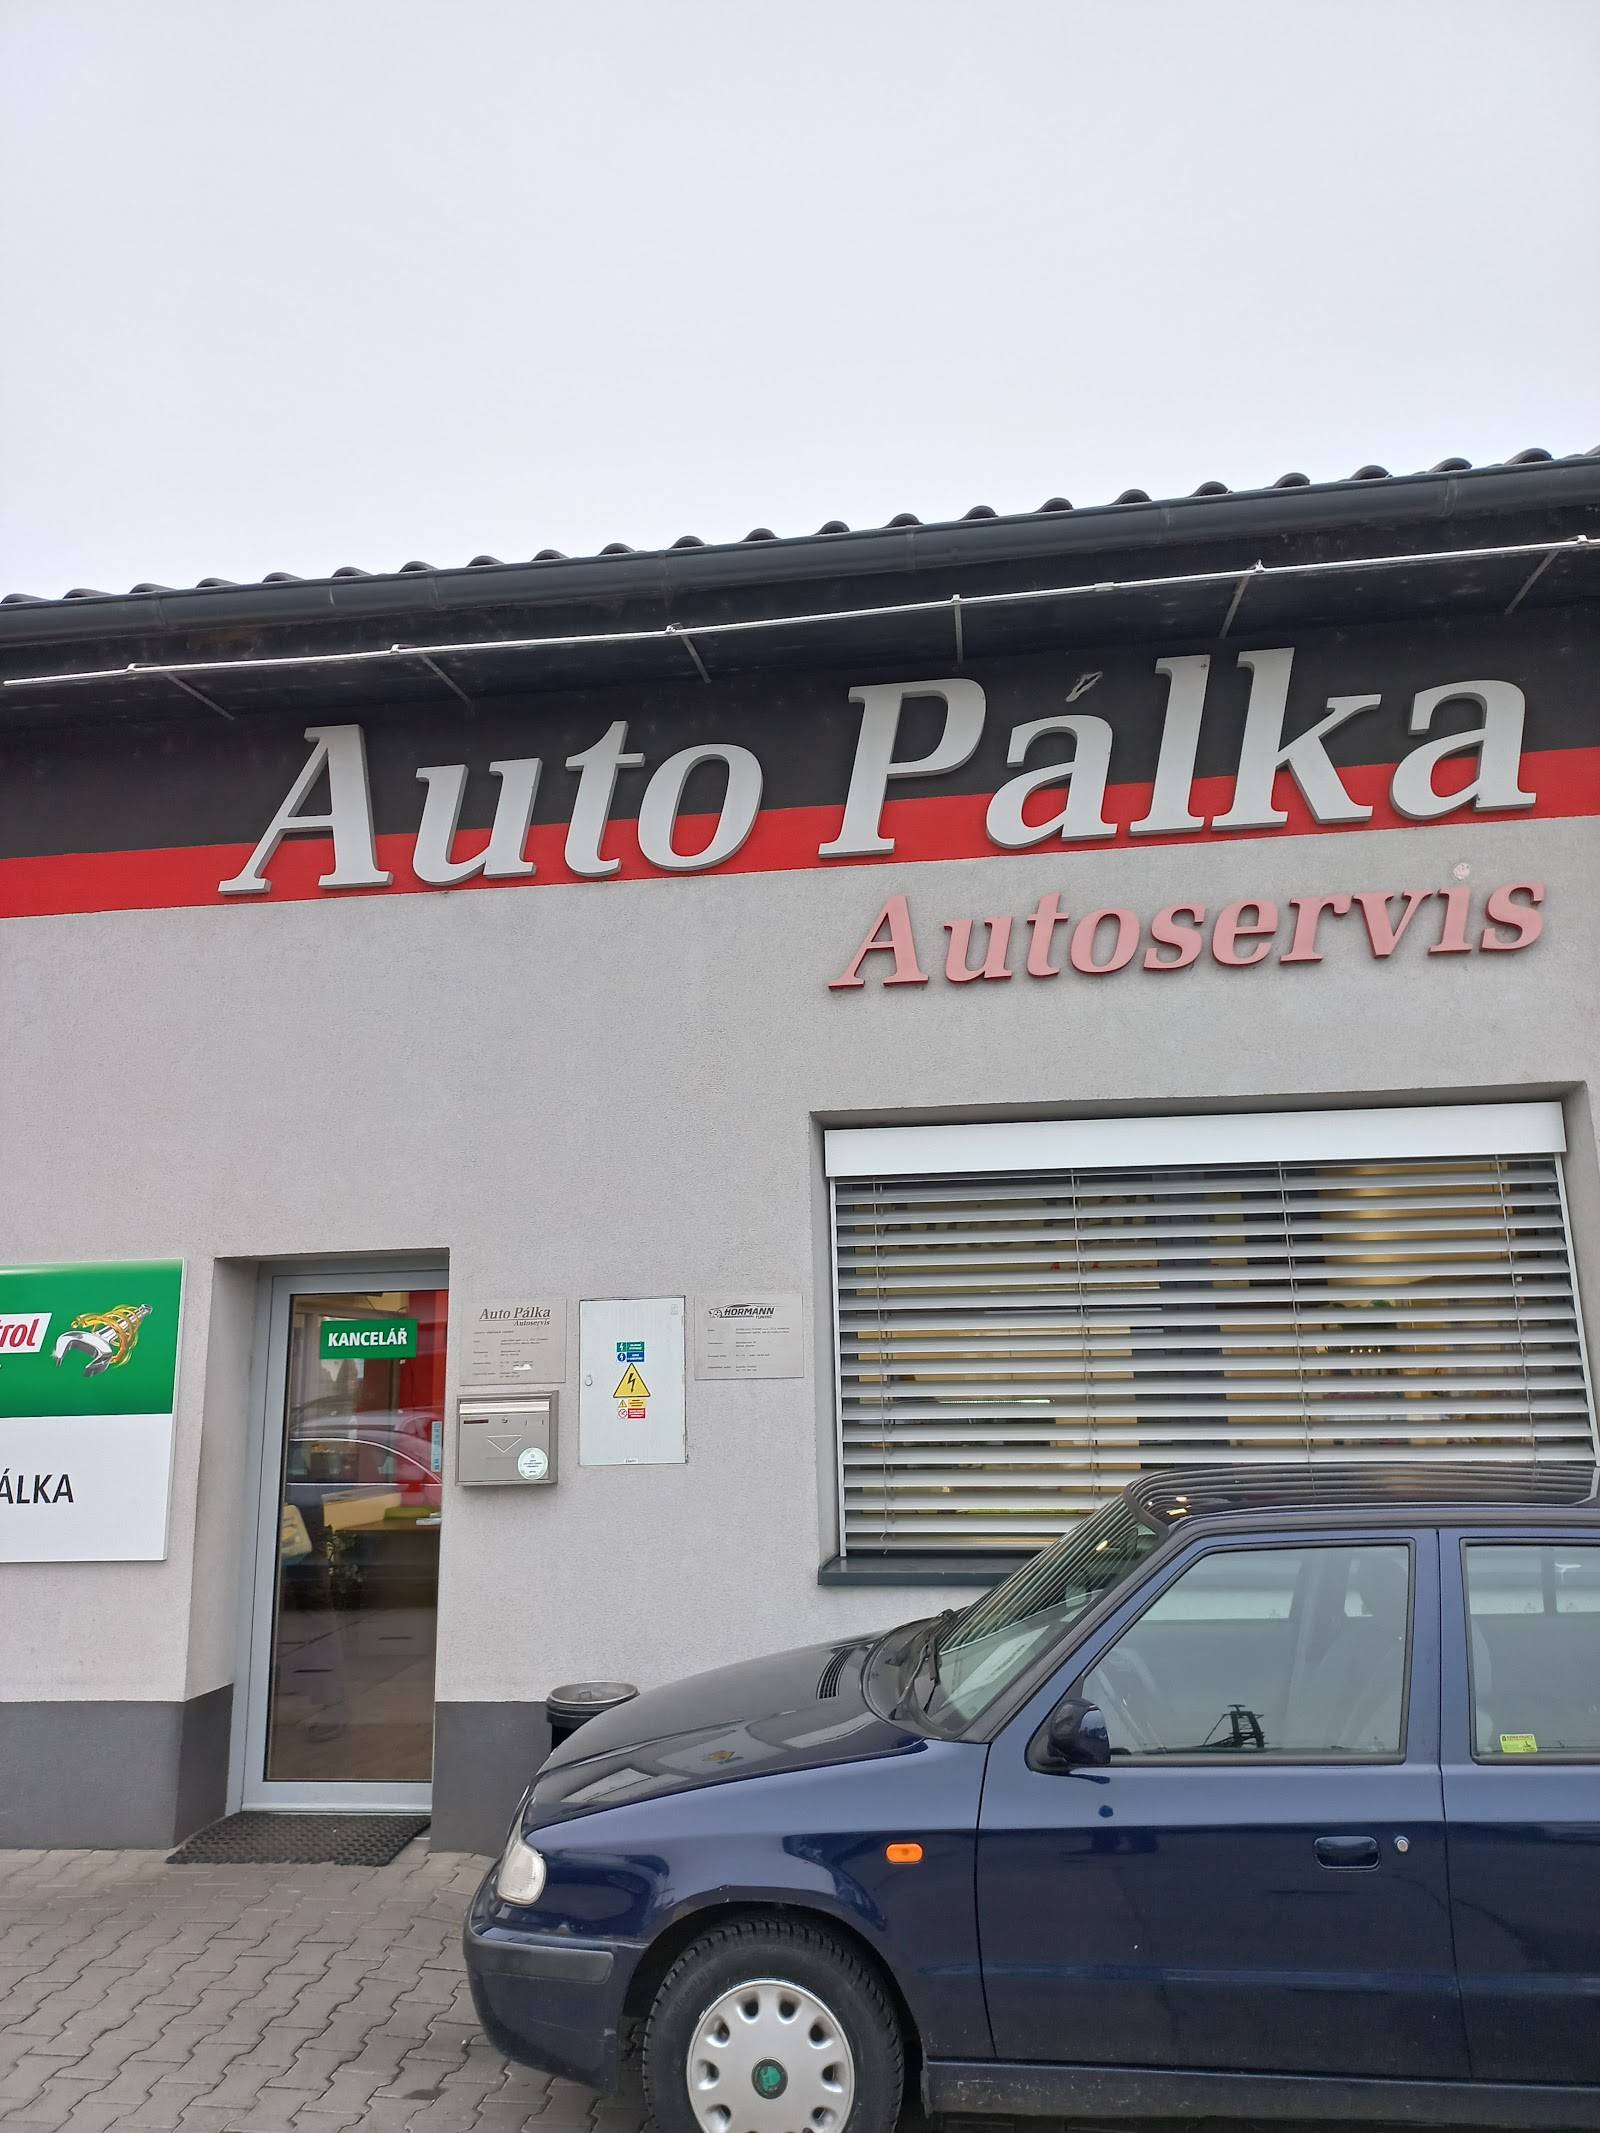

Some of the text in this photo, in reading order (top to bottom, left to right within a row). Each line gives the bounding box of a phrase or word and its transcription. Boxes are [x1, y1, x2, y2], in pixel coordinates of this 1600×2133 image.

[218, 646, 1537, 895] Auto Pálka
[828, 862, 1547, 990] Autoservis
[479, 1306, 551, 1320] Auto Pálka
[724, 1307, 775, 1316] HORMANN
[0, 1318, 40, 1347] rol
[513, 1319, 551, 1328] Autoservis
[328, 1328, 408, 1347] KANCELÁŘ
